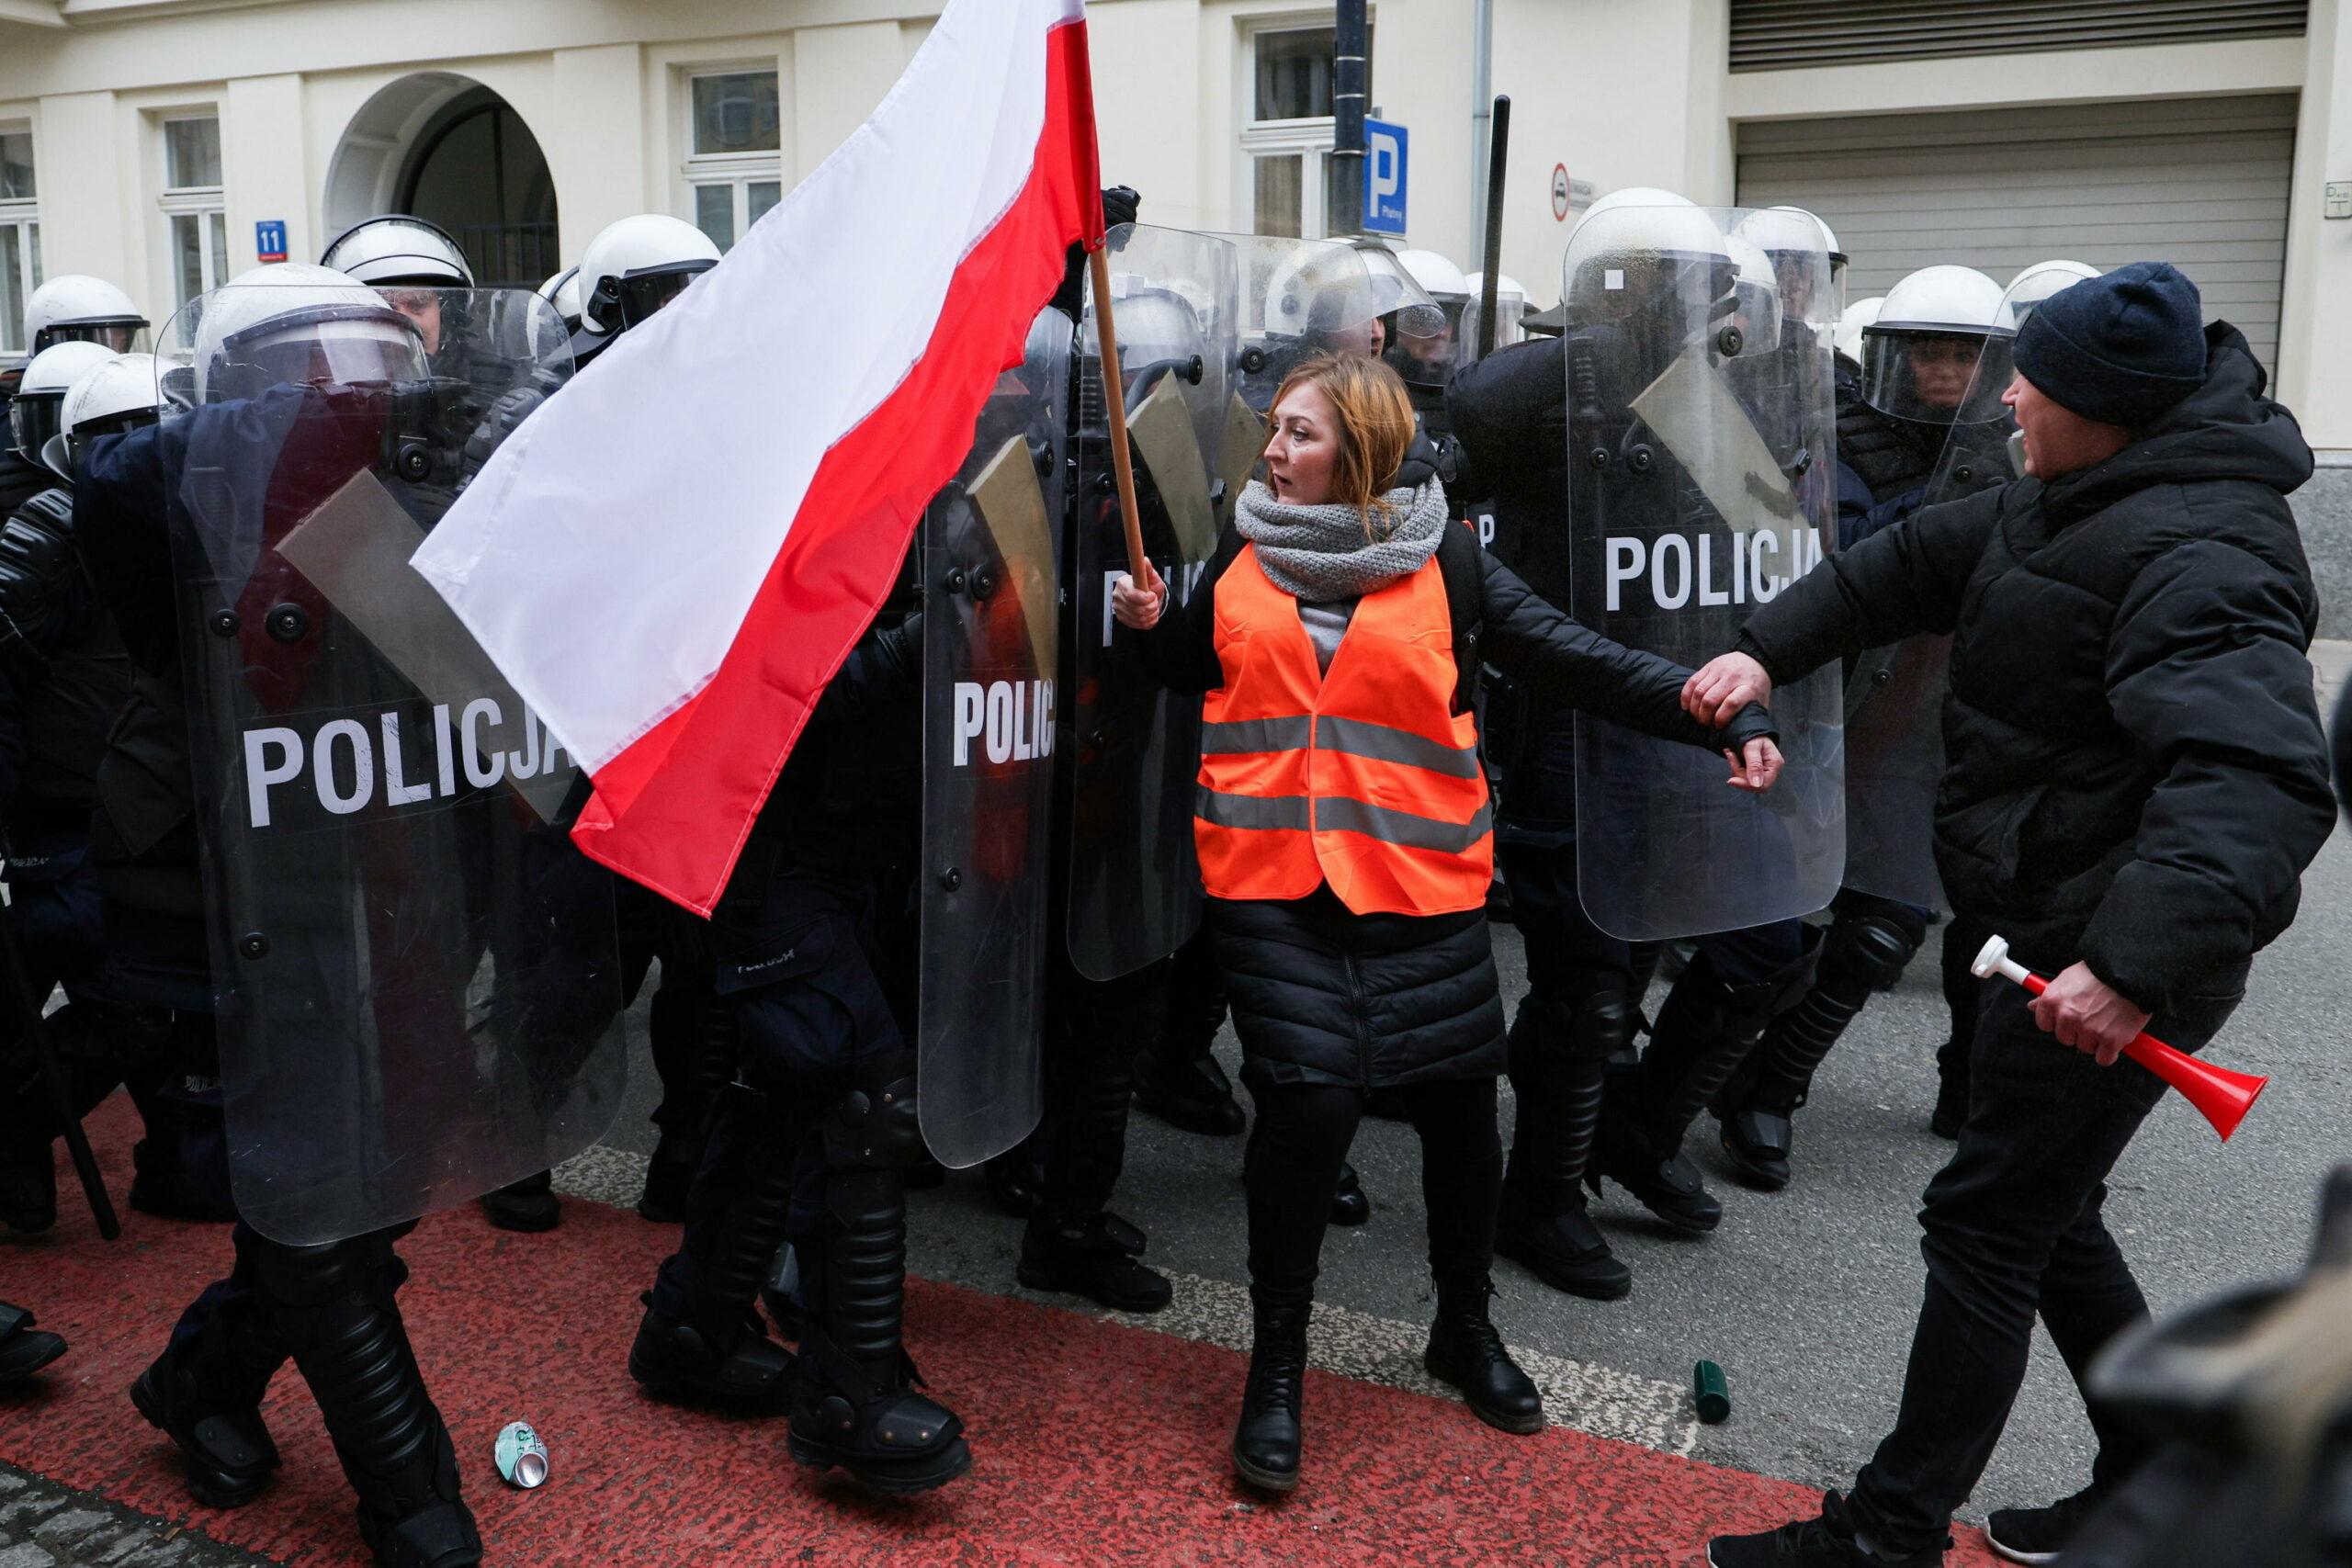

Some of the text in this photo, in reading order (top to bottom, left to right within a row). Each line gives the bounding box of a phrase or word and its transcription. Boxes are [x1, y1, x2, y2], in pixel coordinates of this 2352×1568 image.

[1370, 132, 1398, 218] P
[260, 230, 280, 252] 11
[954, 678, 1056, 766] POLIC
